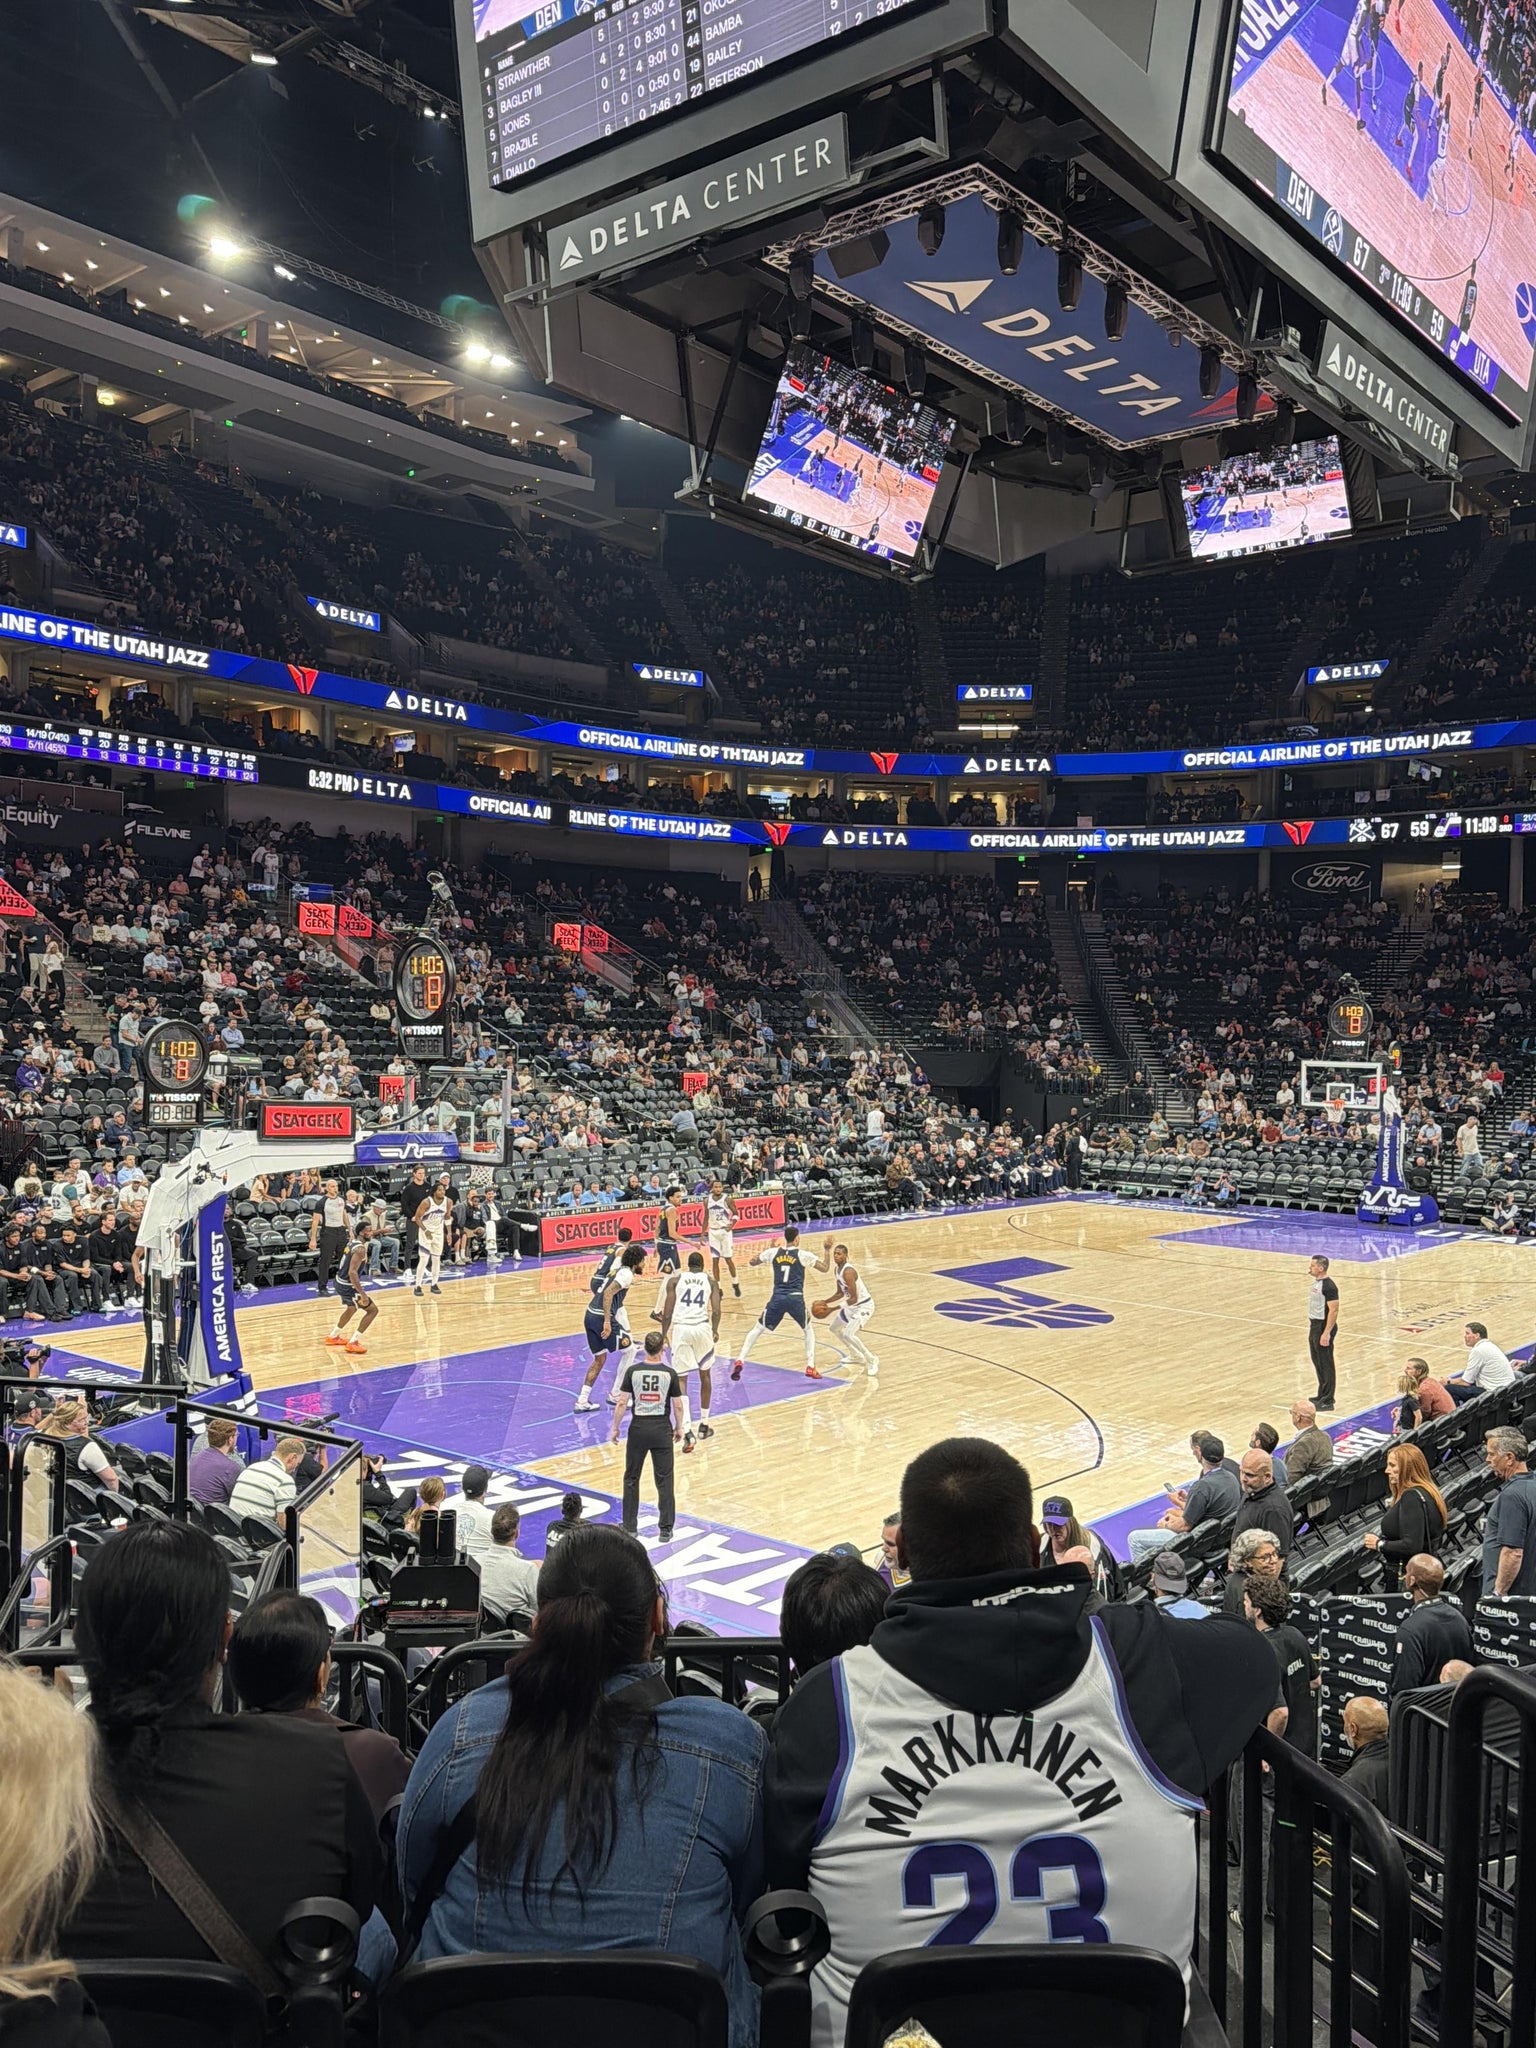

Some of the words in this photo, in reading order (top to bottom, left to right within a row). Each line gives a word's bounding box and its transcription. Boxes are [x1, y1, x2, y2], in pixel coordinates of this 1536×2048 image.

[535, 1, 562, 30] DEN
[686, 8, 697, 24] 21
[686, 32, 699, 48] 44
[705, 14, 743, 41] BAMBA
[498, 55, 551, 91] STRAWTHER
[598, 28, 605, 42] 5
[617, 20, 622, 32] 1
[632, 12, 639, 25] 2
[643, 1, 664, 19] 9:30
[689, 59, 700, 74] 19
[707, 39, 742, 67] BAILEY
[830, 21, 841, 36] 12
[487, 106, 494, 118] 3
[500, 89, 534, 114] BAGLEY
[534, 84, 542, 97] III
[599, 52, 606, 65] 4
[618, 44, 624, 57] 2
[634, 36, 640, 48] 0
[645, 24, 666, 43] 8:30
[671, 19, 675, 31] 1
[690, 83, 702, 99] 22
[709, 56, 763, 91] PETERSON
[490, 129, 496, 141] 5
[502, 114, 530, 137] JONES
[602, 77, 608, 89] 0
[620, 68, 626, 81] 2
[636, 60, 643, 72] 4
[648, 49, 667, 67] 9:01
[671, 43, 678, 56] 0
[491, 151, 497, 163] 7
[504, 133, 538, 158] BRAZILE
[602, 101, 609, 113] 0
[621, 92, 628, 104] 0
[638, 85, 644, 97] 0
[649, 73, 669, 92] 0:50
[673, 68, 680, 81] 0
[492, 174, 500, 185] 11
[505, 158, 536, 180] DIALLO
[650, 98, 671, 116] 7:46
[589, 194, 691, 255] DELTA
[703, 137, 831, 211] CENTER
[1286, 170, 1313, 221] DEN
[1353, 236, 1370, 271] 67
[1391, 272, 1413, 313] 11:03
[1414, 296, 1421, 316] 8
[1430, 309, 1444, 342] 59
[1473, 348, 1490, 384] UTA
[982, 307, 1183, 416] DELTA
[1344, 354, 1393, 410] DELTA
[1397, 397, 1447, 453] CENTER
[774, 504, 788, 518] DEN
[807, 519, 816, 529] 67
[329, 607, 374, 627] DELTA
[40, 620, 69, 640] OF
[72, 626, 110, 651] THE
[113, 634, 164, 662] UTAH
[167, 645, 209, 669] JAZZ
[654, 667, 698, 683] DELTA
[1332, 663, 1382, 681] DELTA
[980, 686, 1025, 699] DELTA
[407, 695, 467, 721] DELTA
[26, 728, 47, 739] 14/19
[99, 740, 110, 749] 20
[118, 742, 128, 751] 23
[210, 756, 219, 765] 22
[227, 759, 237, 768] 121
[28, 741, 44, 751] 5/11
[100, 751, 108, 760] 13
[137, 756, 146, 765] 13
[209, 766, 219, 776] 22
[579, 729, 641, 750] OFFICIAL
[644, 738, 697, 757] AIRLINE
[699, 744, 719, 759] OF
[771, 750, 804, 766] JAZZ
[1183, 750, 1255, 767] OFFICIAL
[1259, 745, 1321, 762] AIRLINE
[1324, 743, 1347, 757] OF
[1350, 739, 1381, 755] THE
[1384, 733, 1431, 752] UTAH
[1432, 730, 1472, 749] JAZZ
[985, 757, 1051, 773] DELTA
[309, 769, 333, 791] 8:32
[334, 774, 352, 792] PM
[469, 795, 531, 818] OFFICIAL
[136, 823, 191, 840] FILEVINE
[608, 813, 627, 828] OF
[630, 816, 656, 831] THE
[658, 819, 697, 836] UTAH
[698, 822, 731, 838] JAZZ
[1381, 823, 1399, 839] 67
[1410, 821, 1429, 837] 59
[1465, 816, 1497, 834] 11:03
[1499, 824, 1513, 833] 3RD
[843, 830, 908, 847] DELTA
[970, 834, 1037, 849] OFFICIAL
[1041, 833, 1102, 848] AIRLINE
[1105, 832, 1129, 847] OF
[1131, 831, 1162, 847] THE
[1164, 830, 1205, 847] UTAH
[1207, 829, 1245, 846] JAZZ
[1306, 864, 1366, 892] Ford
[305, 918, 329, 929] GEEK
[307, 907, 329, 918] SEAT
[412, 956, 444, 975] 11:03
[427, 975, 442, 1010] 8
[1339, 1006, 1364, 1017] 11:03
[411, 1025, 444, 1036] TISSOT
[1350, 1017, 1361, 1034] 8
[159, 1041, 197, 1058] 11:03
[176, 1059, 189, 1081] 8
[164, 1093, 201, 1102] TISSOT
[272, 1112, 344, 1130] SEATGEEK
[1382, 1149, 1390, 1182] AMERICA
[716, 1213, 724, 1221] 22
[738, 1202, 774, 1220] TGEEK
[1362, 1204, 1388, 1213] AMERICA
[555, 1217, 623, 1243] SEATGEEK
[641, 1209, 704, 1234] SEEEK
[211, 1231, 223, 1282] FIRST
[781, 1265, 790, 1282] 7
[680, 1289, 705, 1307] 44
[213, 1284, 233, 1362] AMERICA
[642, 1375, 659, 1391] 52
[1338, 1595, 1387, 1616] NITECRAWLER
[1338, 1631, 1387, 1655] NITECRAWLER
[1338, 1670, 1388, 1695] NITECRAWLER
[864, 1712, 1123, 1838] MARKKANEN
[902, 1832, 1111, 1948] 23
